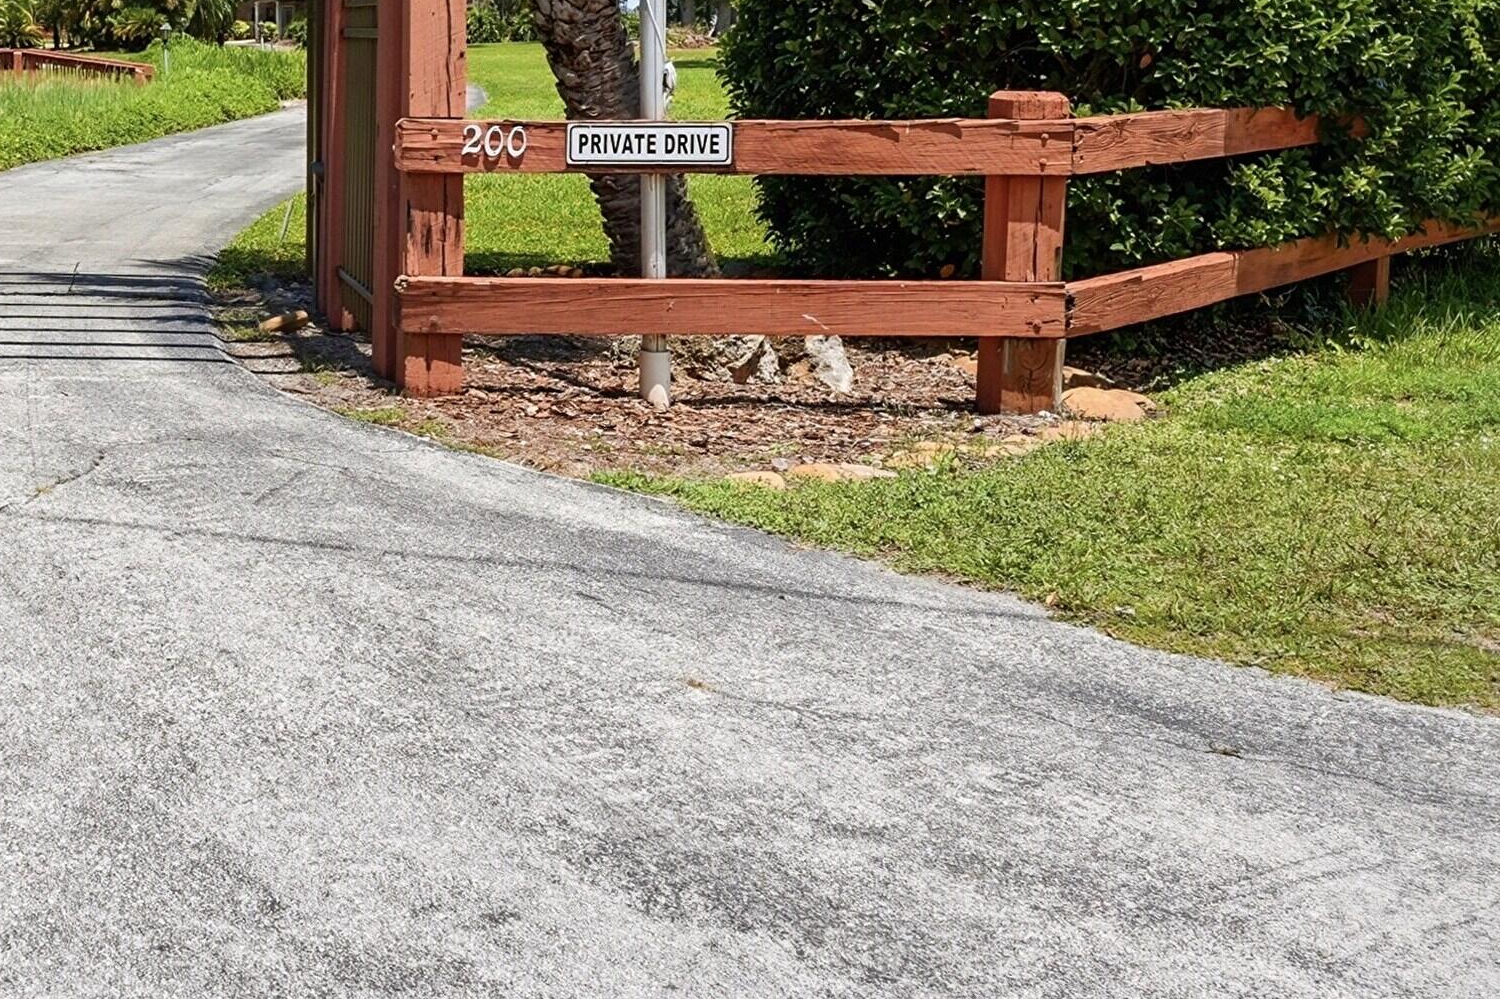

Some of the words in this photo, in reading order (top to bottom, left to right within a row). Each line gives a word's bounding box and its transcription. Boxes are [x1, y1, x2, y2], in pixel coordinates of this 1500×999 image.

[461, 124, 528, 158] 200
[578, 133, 657, 155] PRIVATE
[665, 133, 720, 155] DRIVE
